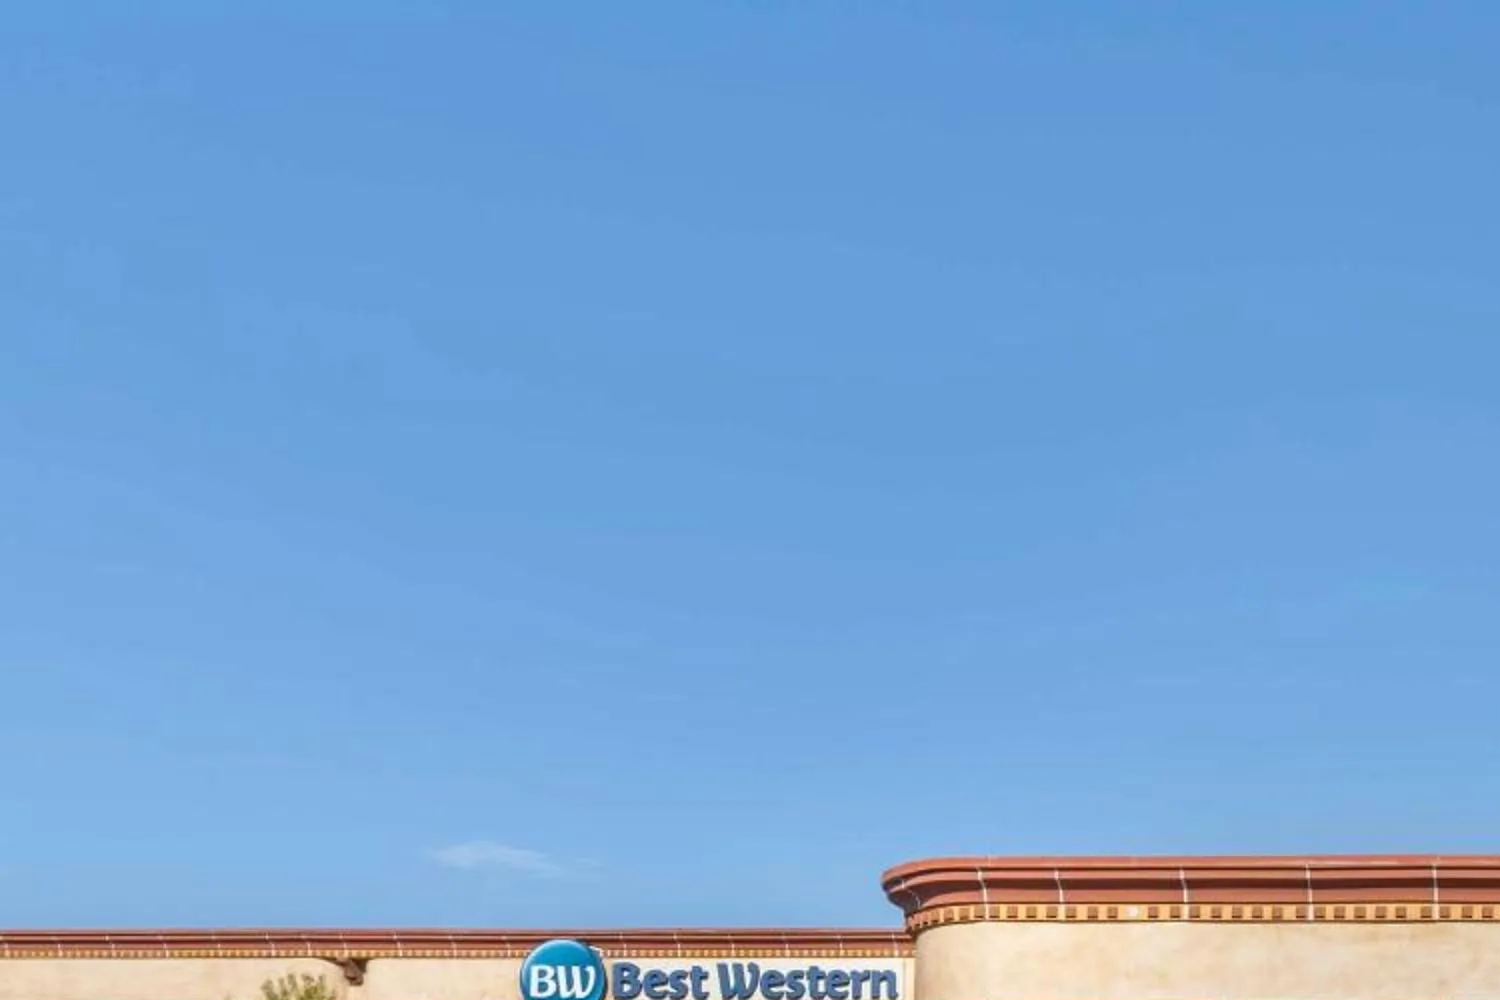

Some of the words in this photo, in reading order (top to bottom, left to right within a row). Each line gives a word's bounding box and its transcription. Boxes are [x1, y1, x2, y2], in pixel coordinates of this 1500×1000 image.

[529, 965, 596, 999] BW
[612, 961, 709, 1000] Best
[716, 961, 898, 1000] Western
